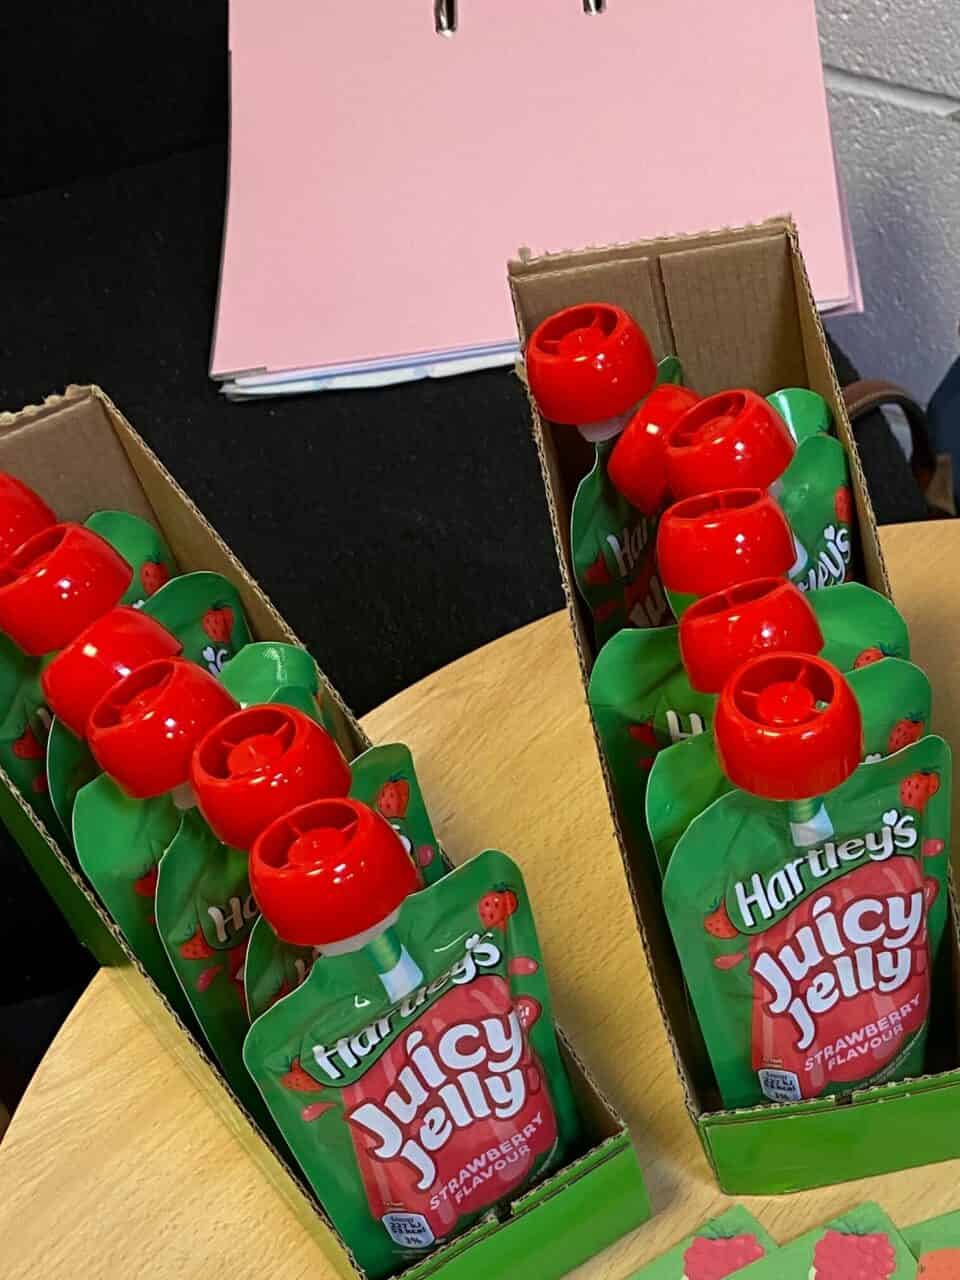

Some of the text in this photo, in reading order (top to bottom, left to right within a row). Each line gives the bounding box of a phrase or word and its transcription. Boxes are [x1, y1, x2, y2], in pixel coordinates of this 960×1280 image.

[735, 809, 918, 927] Hartley's
[753, 894, 923, 1014] Juicy
[788, 946, 911, 1050] Jelly
[350, 1010, 526, 1159] Juicy
[804, 995, 921, 1072] STRAWBERRY
[827, 1022, 905, 1071] FLAVOUR
[400, 1069, 527, 1190] Jelly
[430, 1112, 543, 1210] STRAWBERRY
[455, 1144, 531, 1204] FLAVOUR
